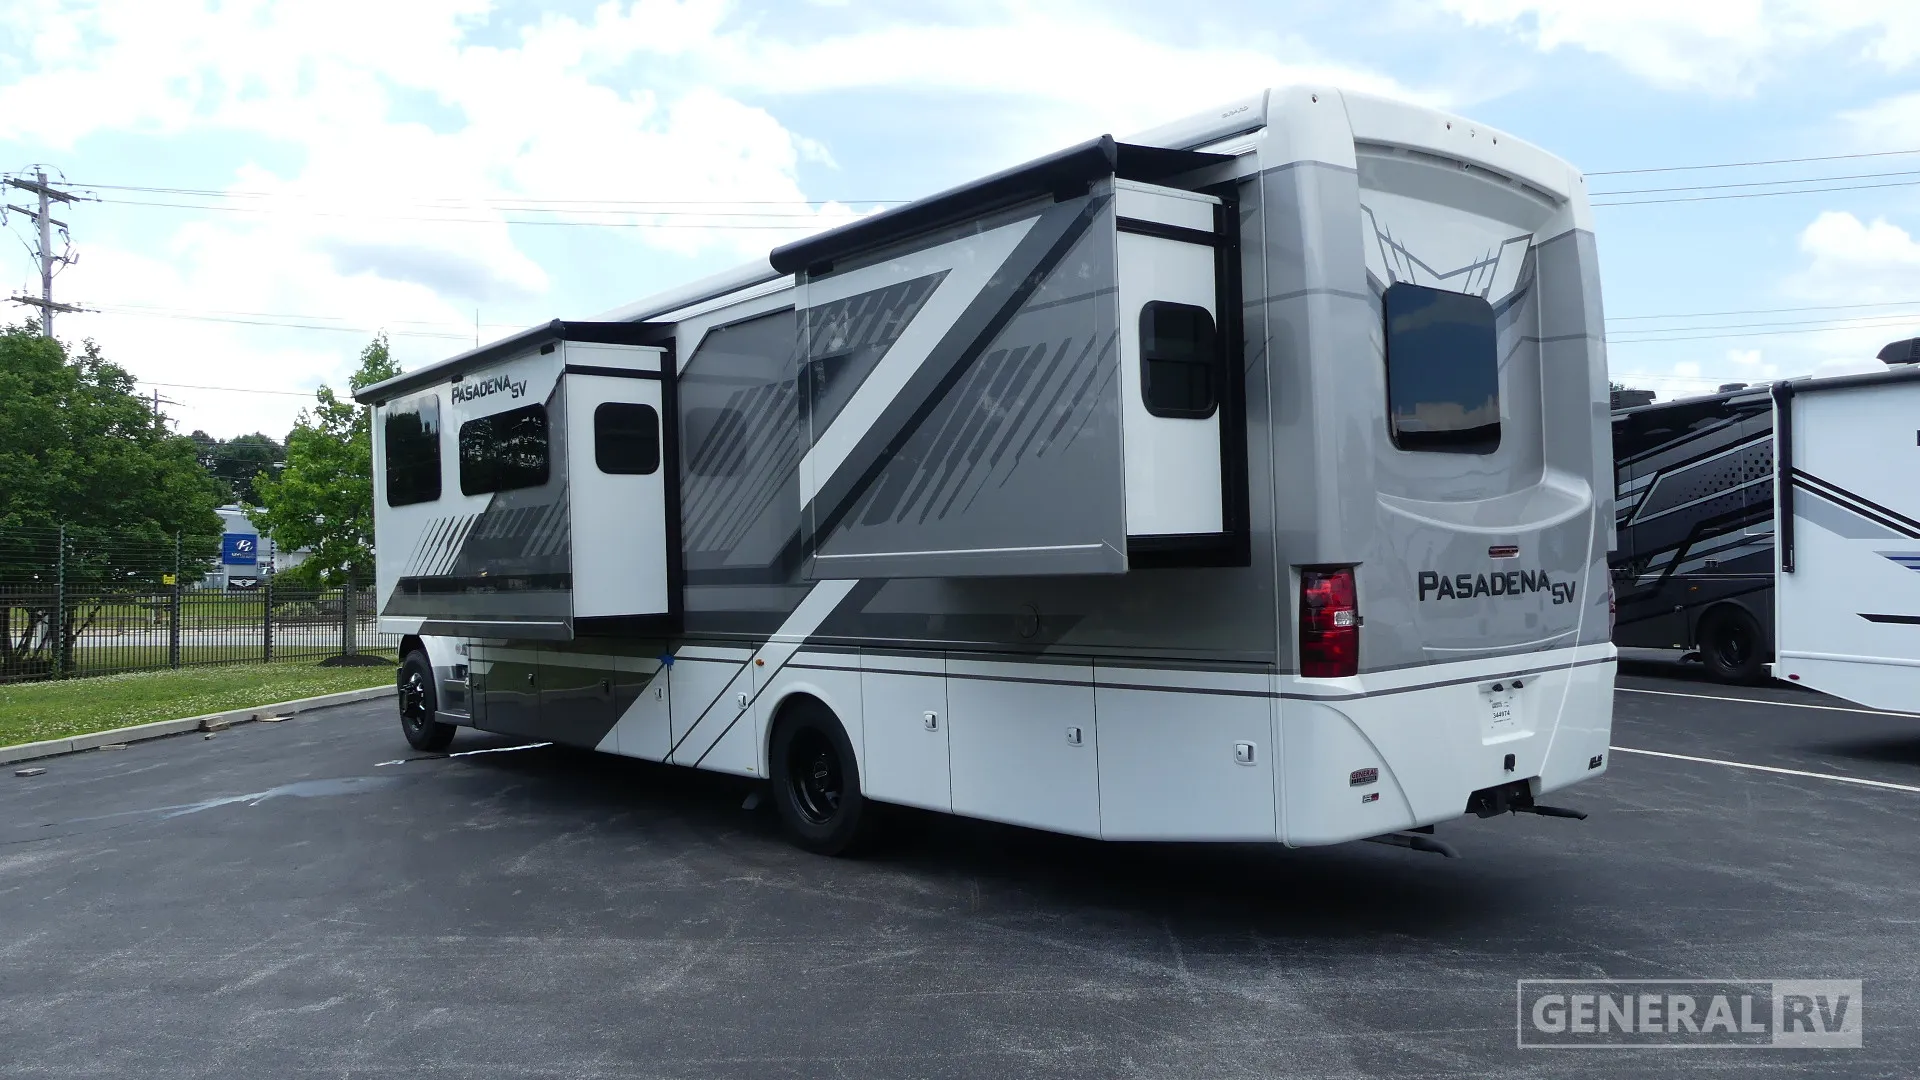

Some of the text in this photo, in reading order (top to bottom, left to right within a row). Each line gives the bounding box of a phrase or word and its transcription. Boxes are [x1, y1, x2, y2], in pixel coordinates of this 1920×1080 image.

[452, 374, 527, 405] PASADENA SV
[1418, 569, 1576, 605] PASADENA SV
[1351, 769, 1377, 779] GENERAL
